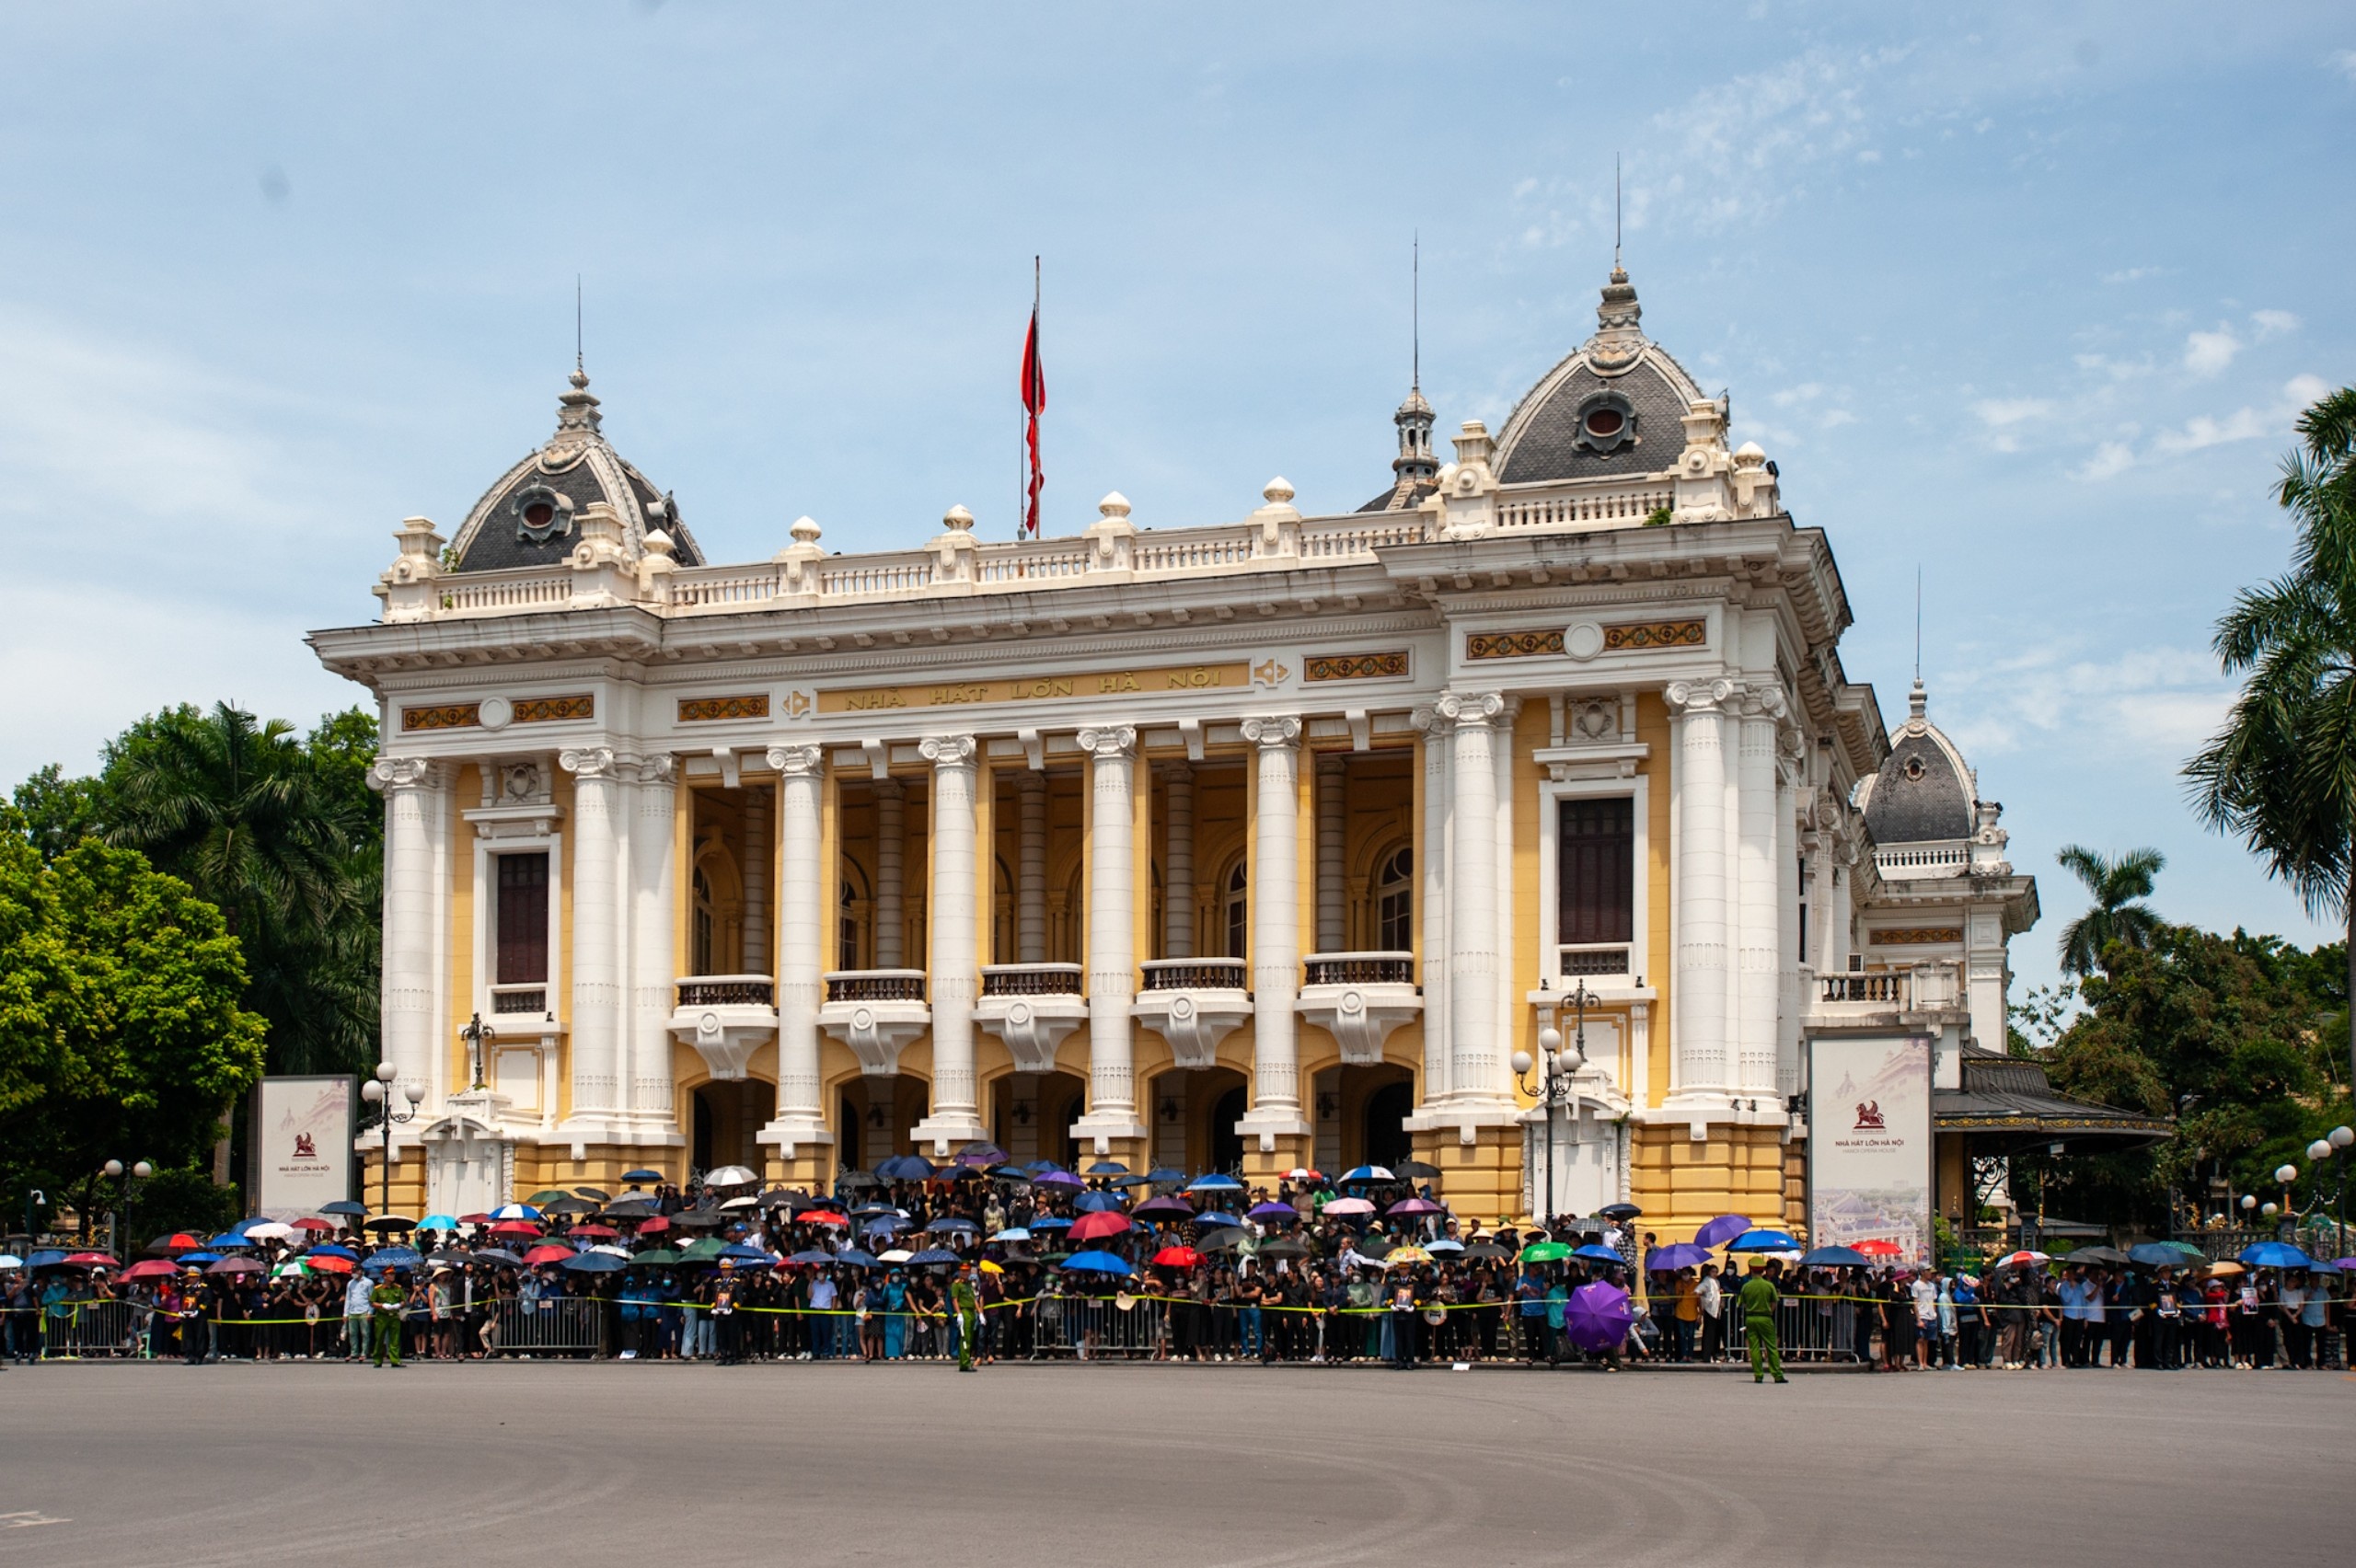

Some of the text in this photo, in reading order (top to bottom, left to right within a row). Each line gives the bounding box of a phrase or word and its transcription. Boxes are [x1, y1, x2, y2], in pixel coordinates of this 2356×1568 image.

[846, 667, 1221, 710] NHÀ HÁT LỚN HÀ NỘI
[1891, 1138, 1904, 1147] NỘI
